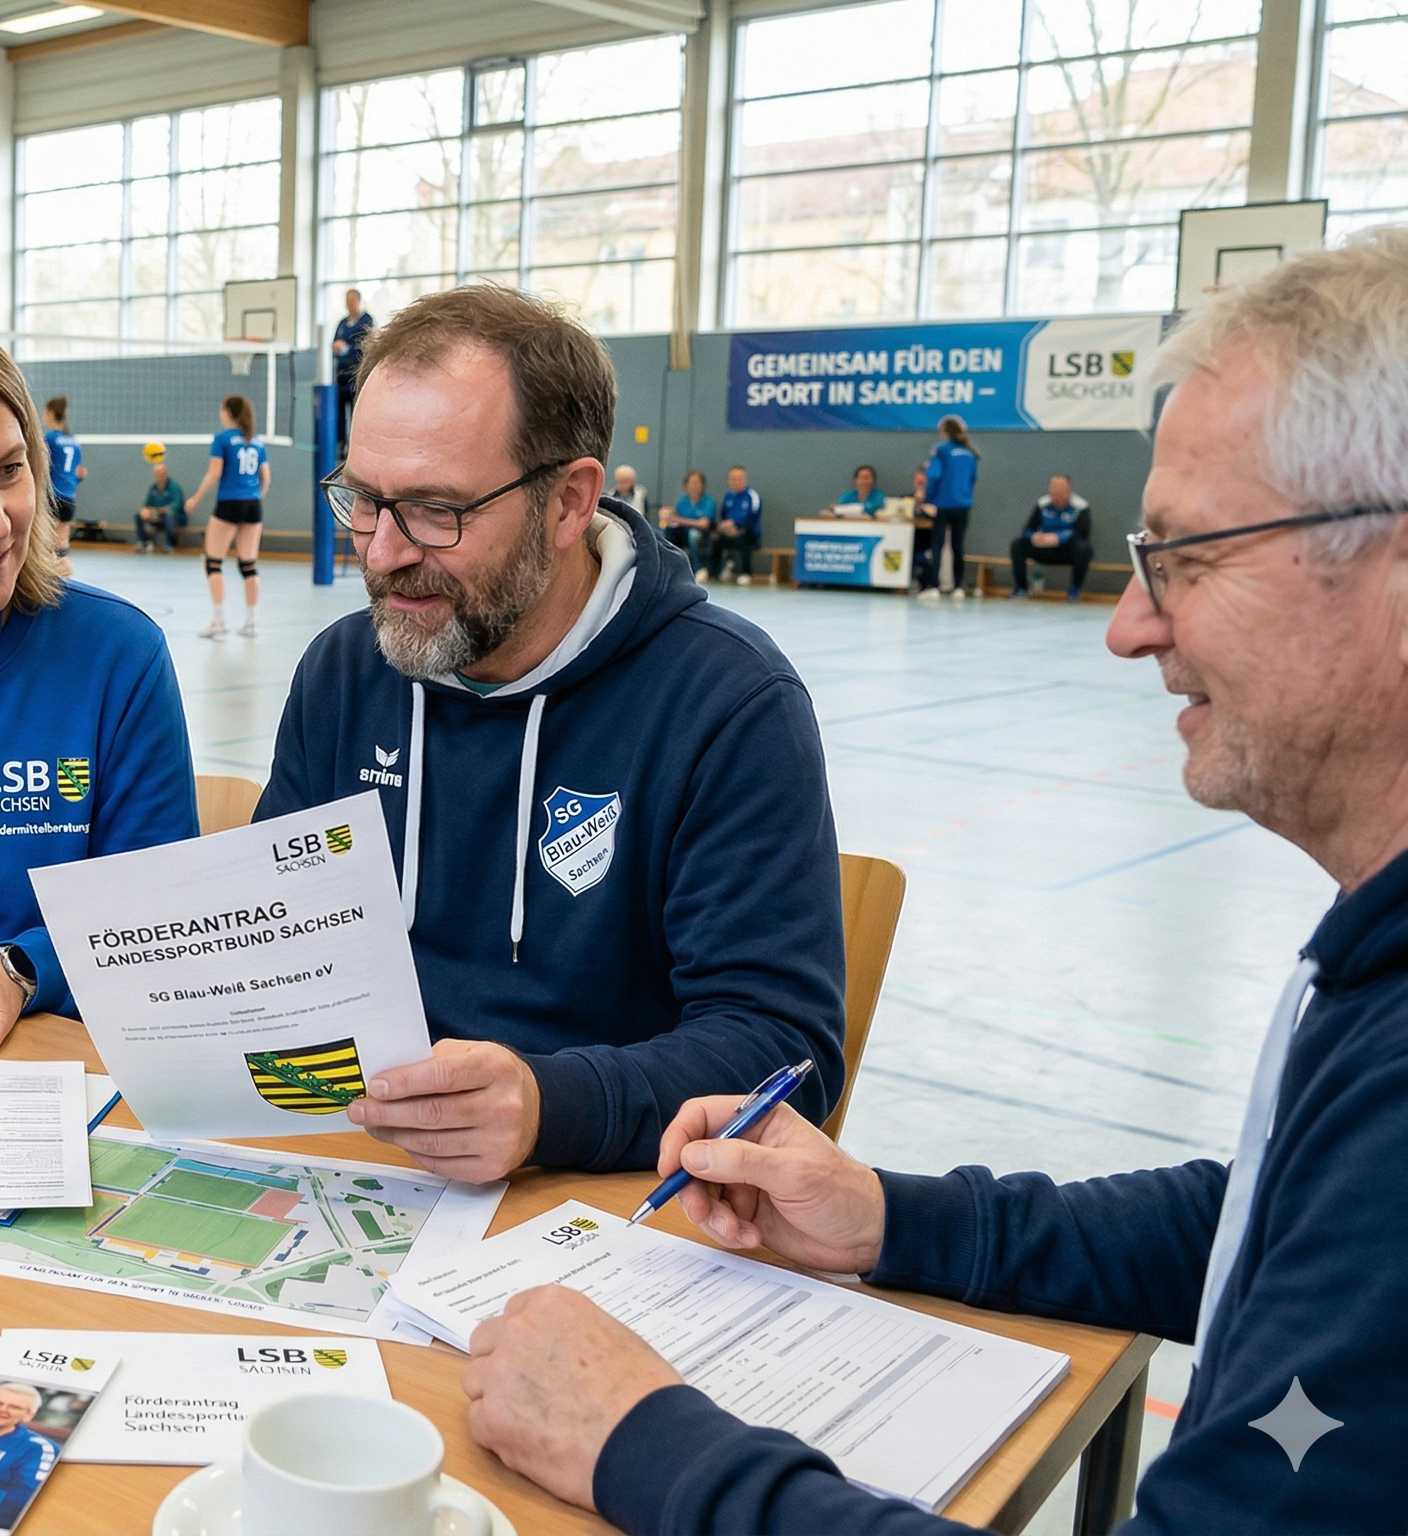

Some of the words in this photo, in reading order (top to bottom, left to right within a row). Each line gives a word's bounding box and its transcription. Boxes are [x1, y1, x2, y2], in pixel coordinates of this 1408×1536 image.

[747, 350, 889, 378] GEMEINSAM
[893, 344, 943, 375] FÜR
[948, 347, 1003, 373] DEN
[1049, 351, 1103, 377] LSB
[747, 381, 824, 406] SPORT
[828, 381, 855, 405] IN
[859, 379, 973, 405] SACHSEN
[554, 799, 583, 824] SG
[546, 805, 617, 862] Blau-Weiß
[272, 833, 321, 862] LSB
[89, 901, 288, 950] FÖRDERANTRAG
[95, 929, 275, 968] LANDESSPORTBUND
[280, 906, 364, 939] SACHSEN
[149, 991, 170, 1003] SG
[174, 981, 246, 1001] Blau-Weiß
[250, 971, 311, 990] Sachsen
[542, 1225, 581, 1245] LSB
[23, 1349, 68, 1365] LSB
[237, 1347, 308, 1363] LSB
[125, 1395, 238, 1409] Förderantrag
[125, 1421, 206, 1433] Sachsen
